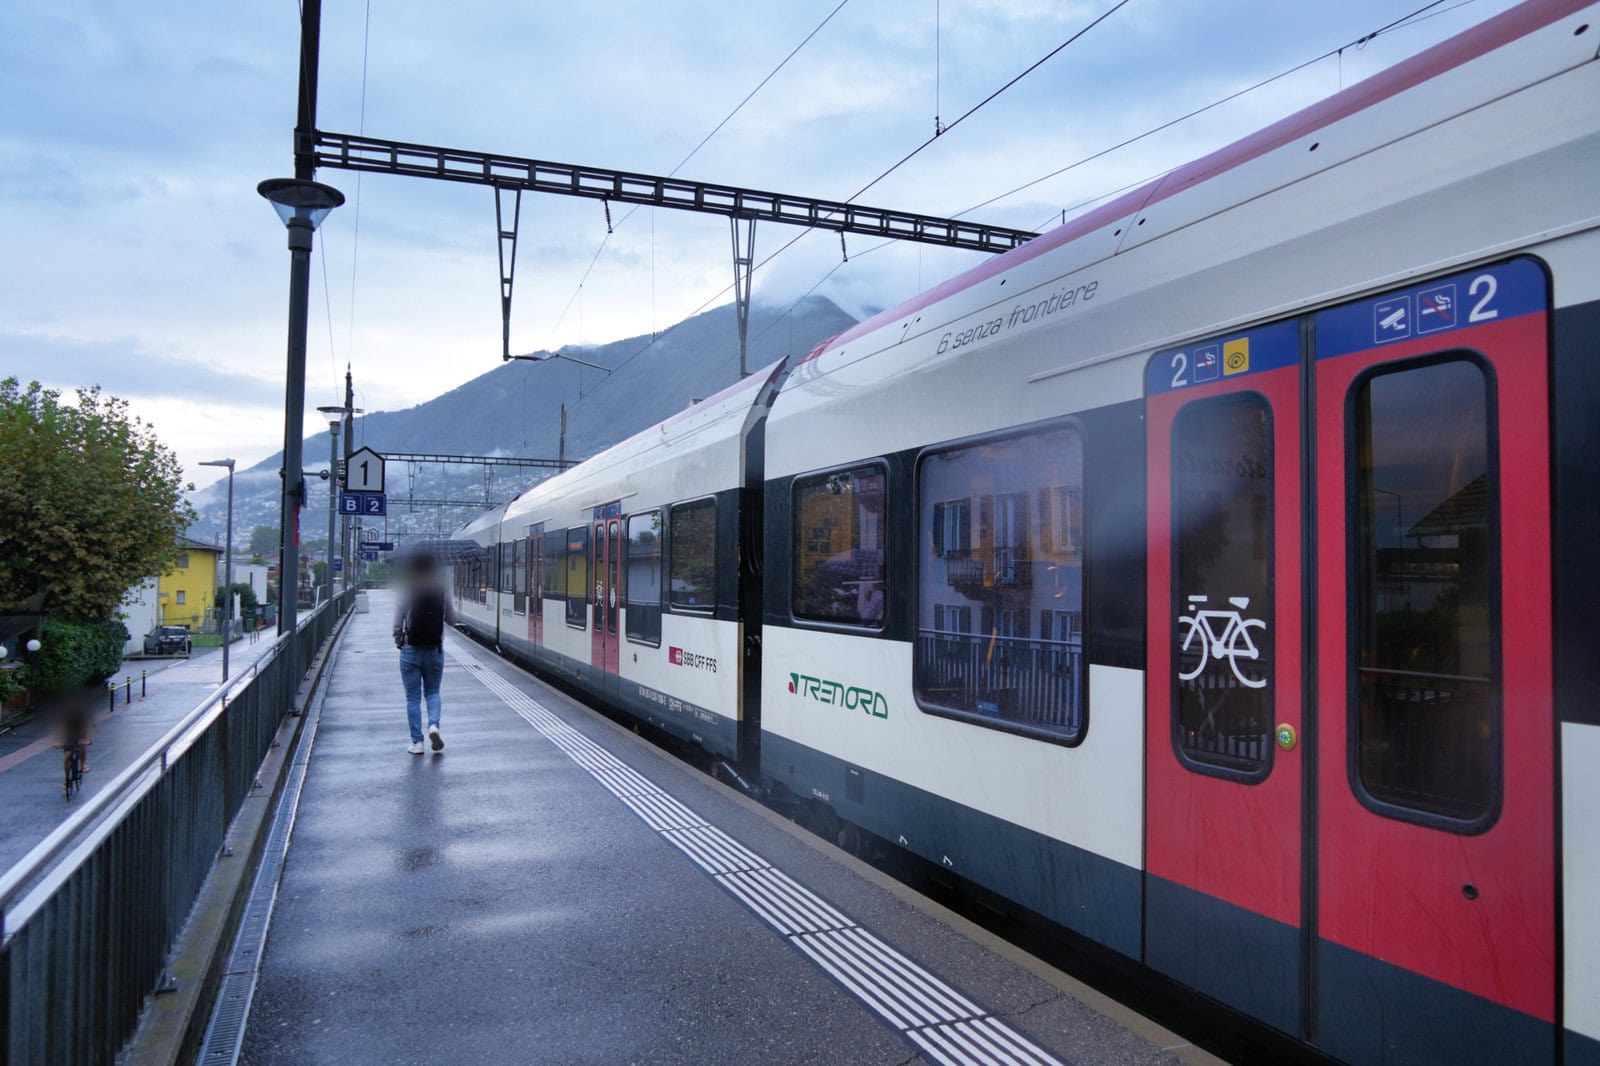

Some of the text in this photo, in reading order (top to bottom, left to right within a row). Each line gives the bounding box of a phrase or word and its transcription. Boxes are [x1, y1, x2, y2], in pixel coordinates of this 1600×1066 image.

[1467, 274, 1498, 323] 2
[936, 280, 1099, 355] 6 senza frontiere
[1170, 352, 1188, 388] 2
[360, 460, 369, 486] 1
[346, 500, 379, 512] B 2
[683, 651, 717, 673] SBB CFF FFS
[799, 674, 889, 720] TRENORD
